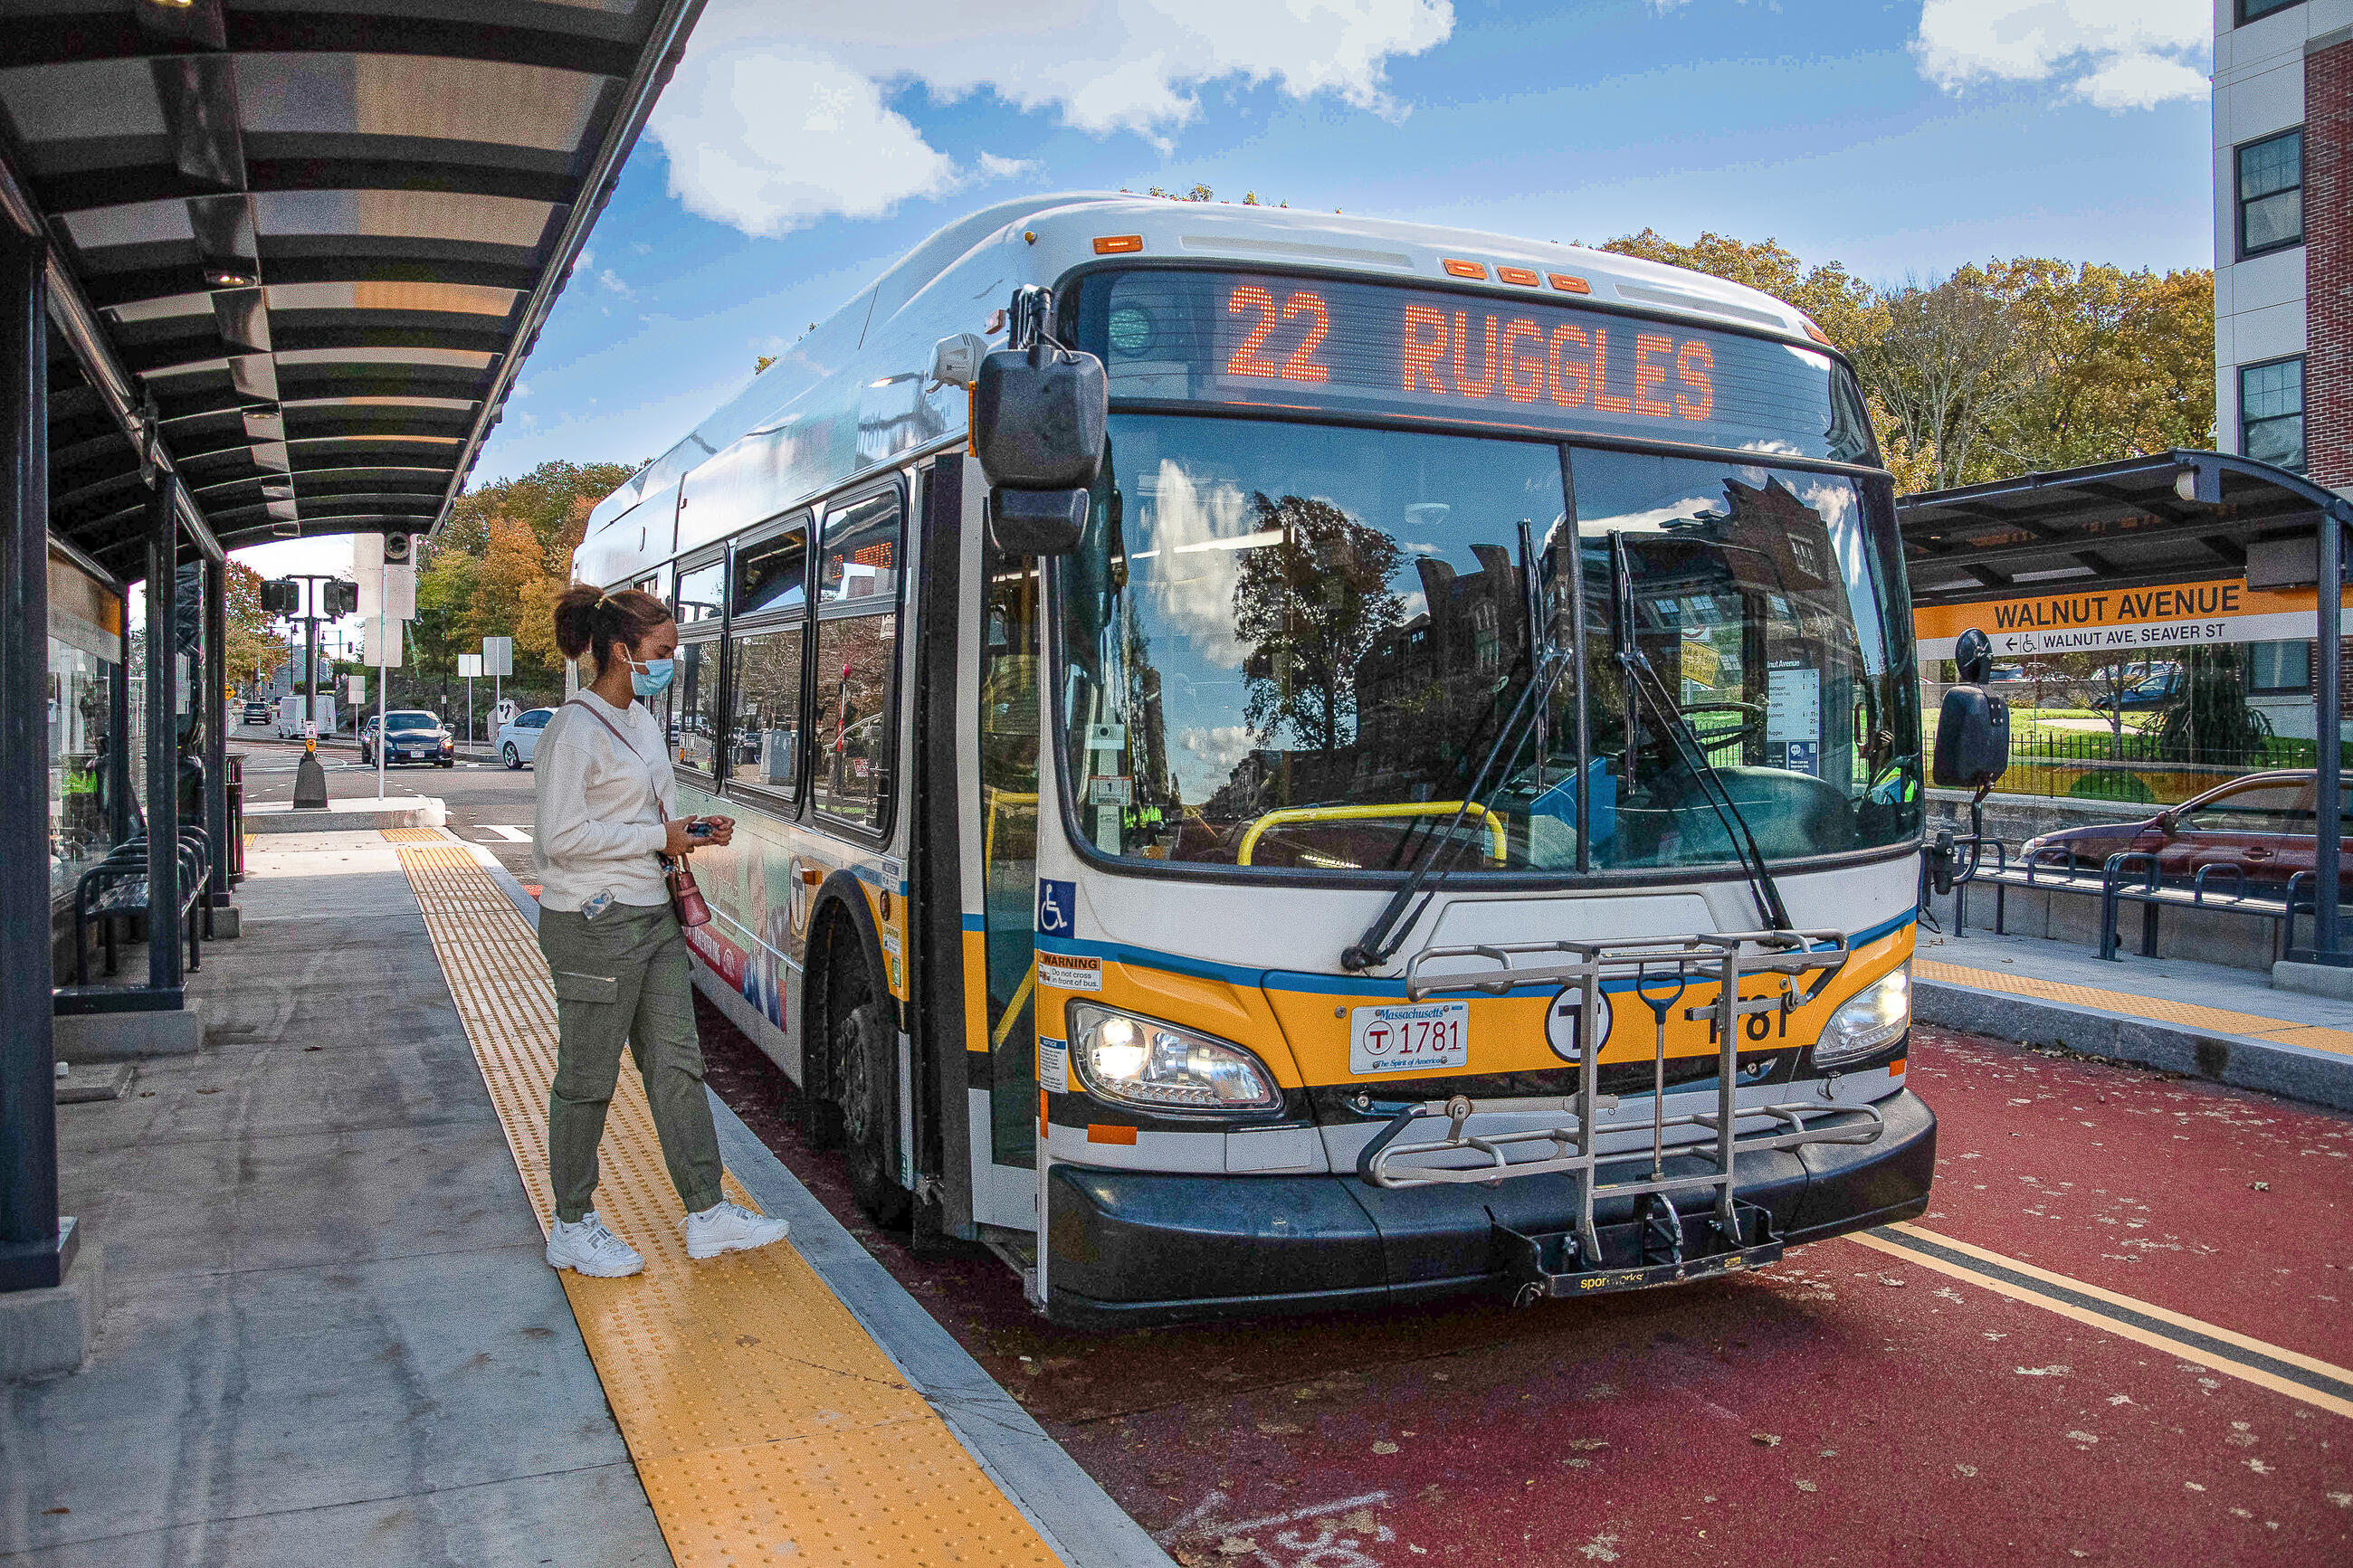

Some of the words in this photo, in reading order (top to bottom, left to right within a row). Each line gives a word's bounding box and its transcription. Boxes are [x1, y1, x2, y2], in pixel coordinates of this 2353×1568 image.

[1225, 284, 1329, 384] 22
[1403, 303, 1716, 421] RUGGLES
[1995, 597, 2109, 629] WALNUT
[2117, 584, 2240, 620] AVENUE
[2043, 632, 2102, 649] WALNUT
[2106, 630, 2137, 645] AVE,
[2142, 626, 2200, 641] SEAVER
[2205, 623, 2225, 637] ST
[1778, 660, 1800, 668] Avenue
[1043, 954, 1098, 969] WARNING
[1052, 967, 1061, 975] Do
[1061, 969, 1072, 977] not
[1072, 972, 1091, 980] cross
[1057, 977, 1073, 985] front
[1074, 978, 1082, 986] of
[1083, 979, 1099, 987] bus.
[1379, 1008, 1443, 1021] Massachusetts
[1708, 992, 1787, 1045] 181
[1368, 1029, 1388, 1049] T
[1399, 1020, 1462, 1055] 1781
[1377, 1060, 1389, 1068] The
[1389, 1059, 1407, 1069] Spirit
[1407, 1058, 1415, 1068] of
[1579, 1273, 1644, 1290] spororks
